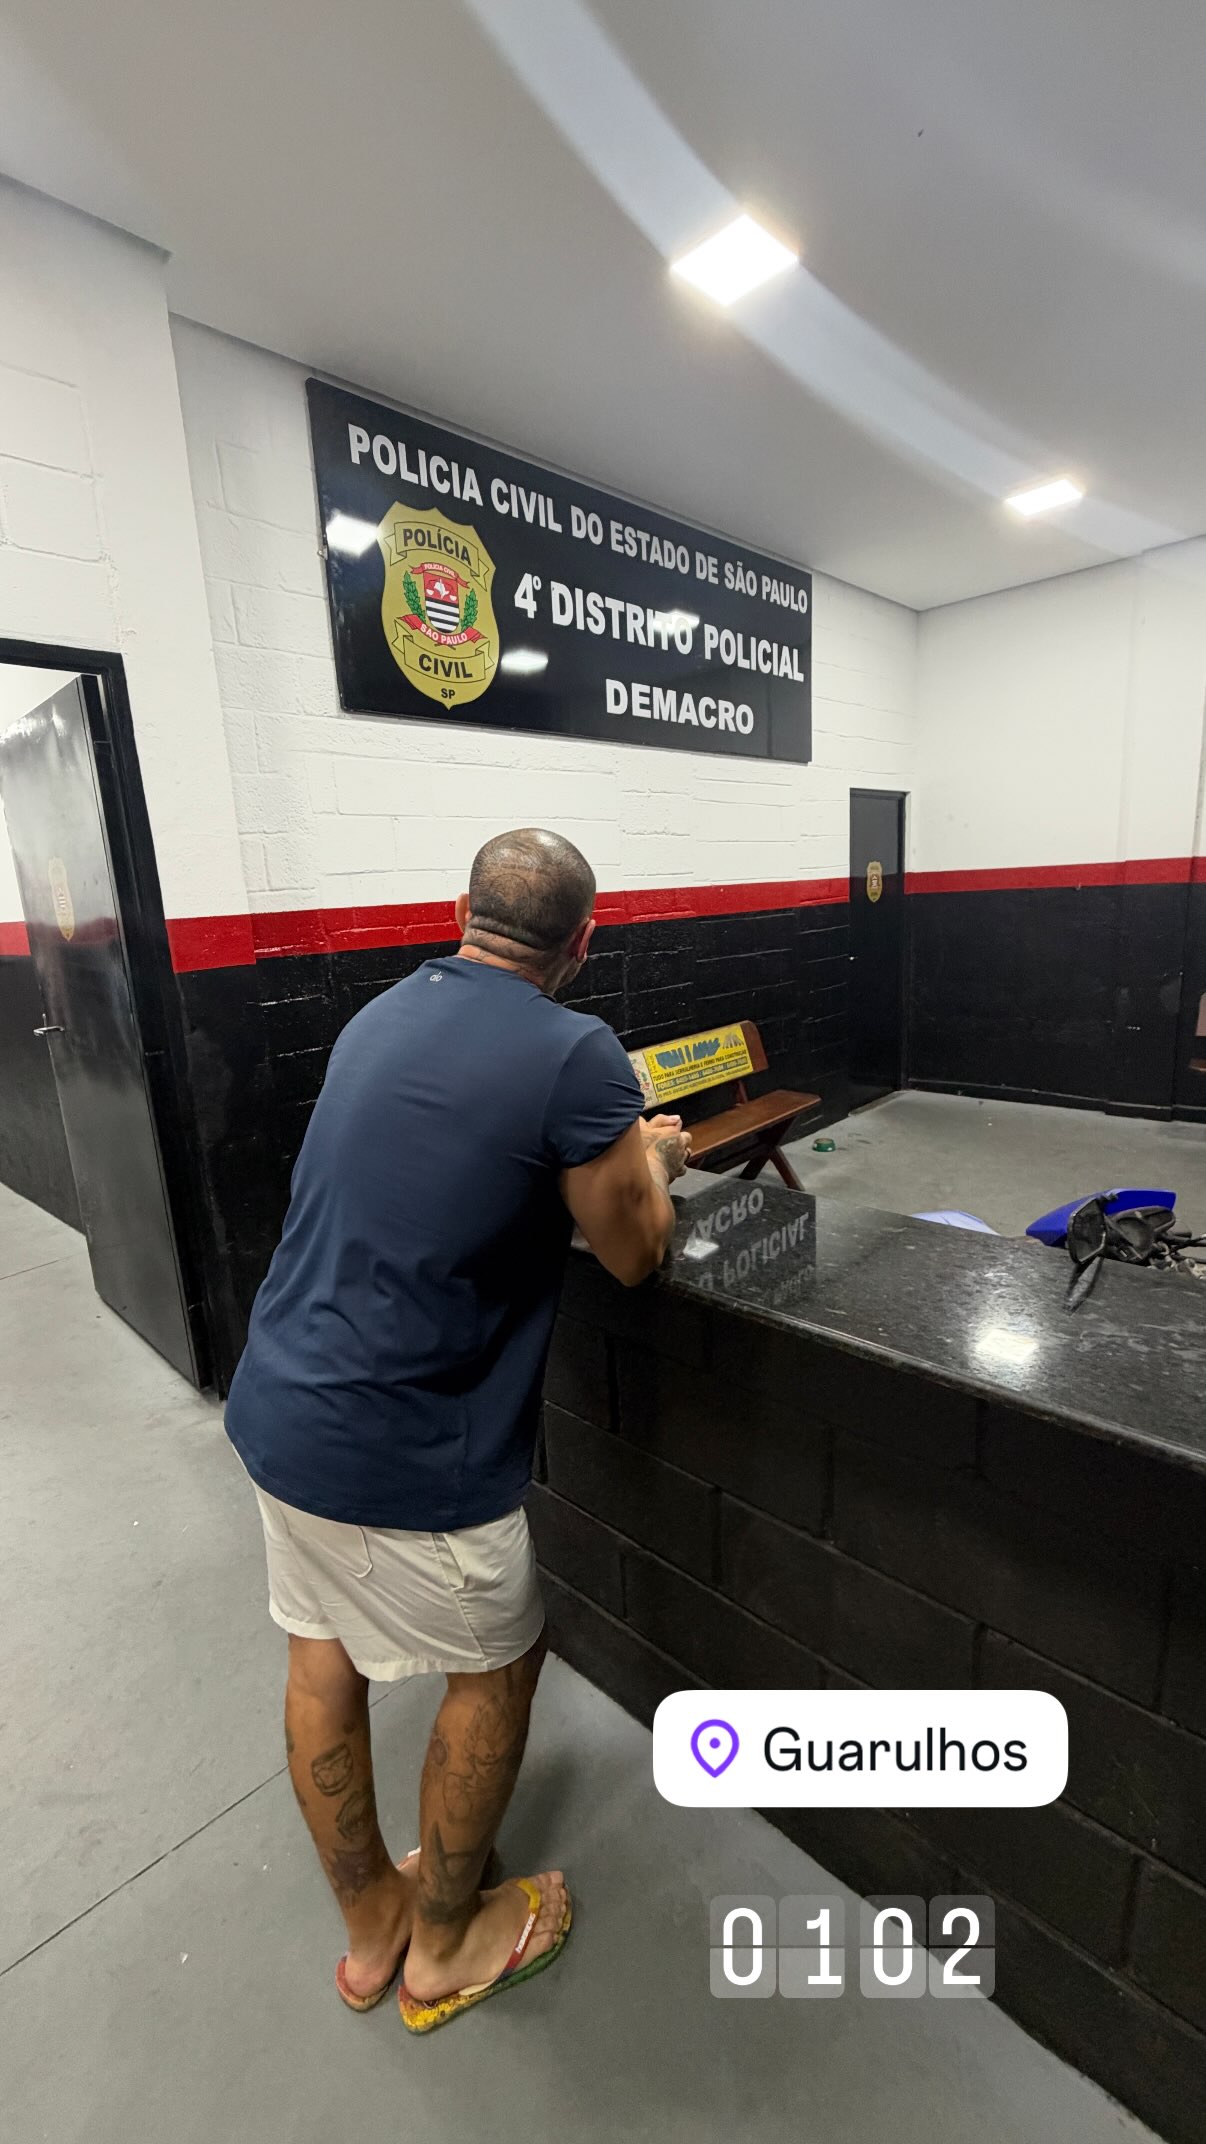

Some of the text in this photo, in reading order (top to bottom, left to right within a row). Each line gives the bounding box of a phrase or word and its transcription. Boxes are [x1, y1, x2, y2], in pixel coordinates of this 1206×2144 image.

[348, 423, 808, 614] POLICIA CIVIL DO ESTADO DE SÃO PAULO
[403, 528, 472, 566] POLÍCIA
[441, 633, 468, 645] PAULO
[550, 580, 693, 655] DISTRITO
[704, 623, 804, 682] POLICIAL
[418, 653, 473, 679] CIVIL
[440, 687, 456, 699] SP
[605, 678, 754, 735] DEMACRO
